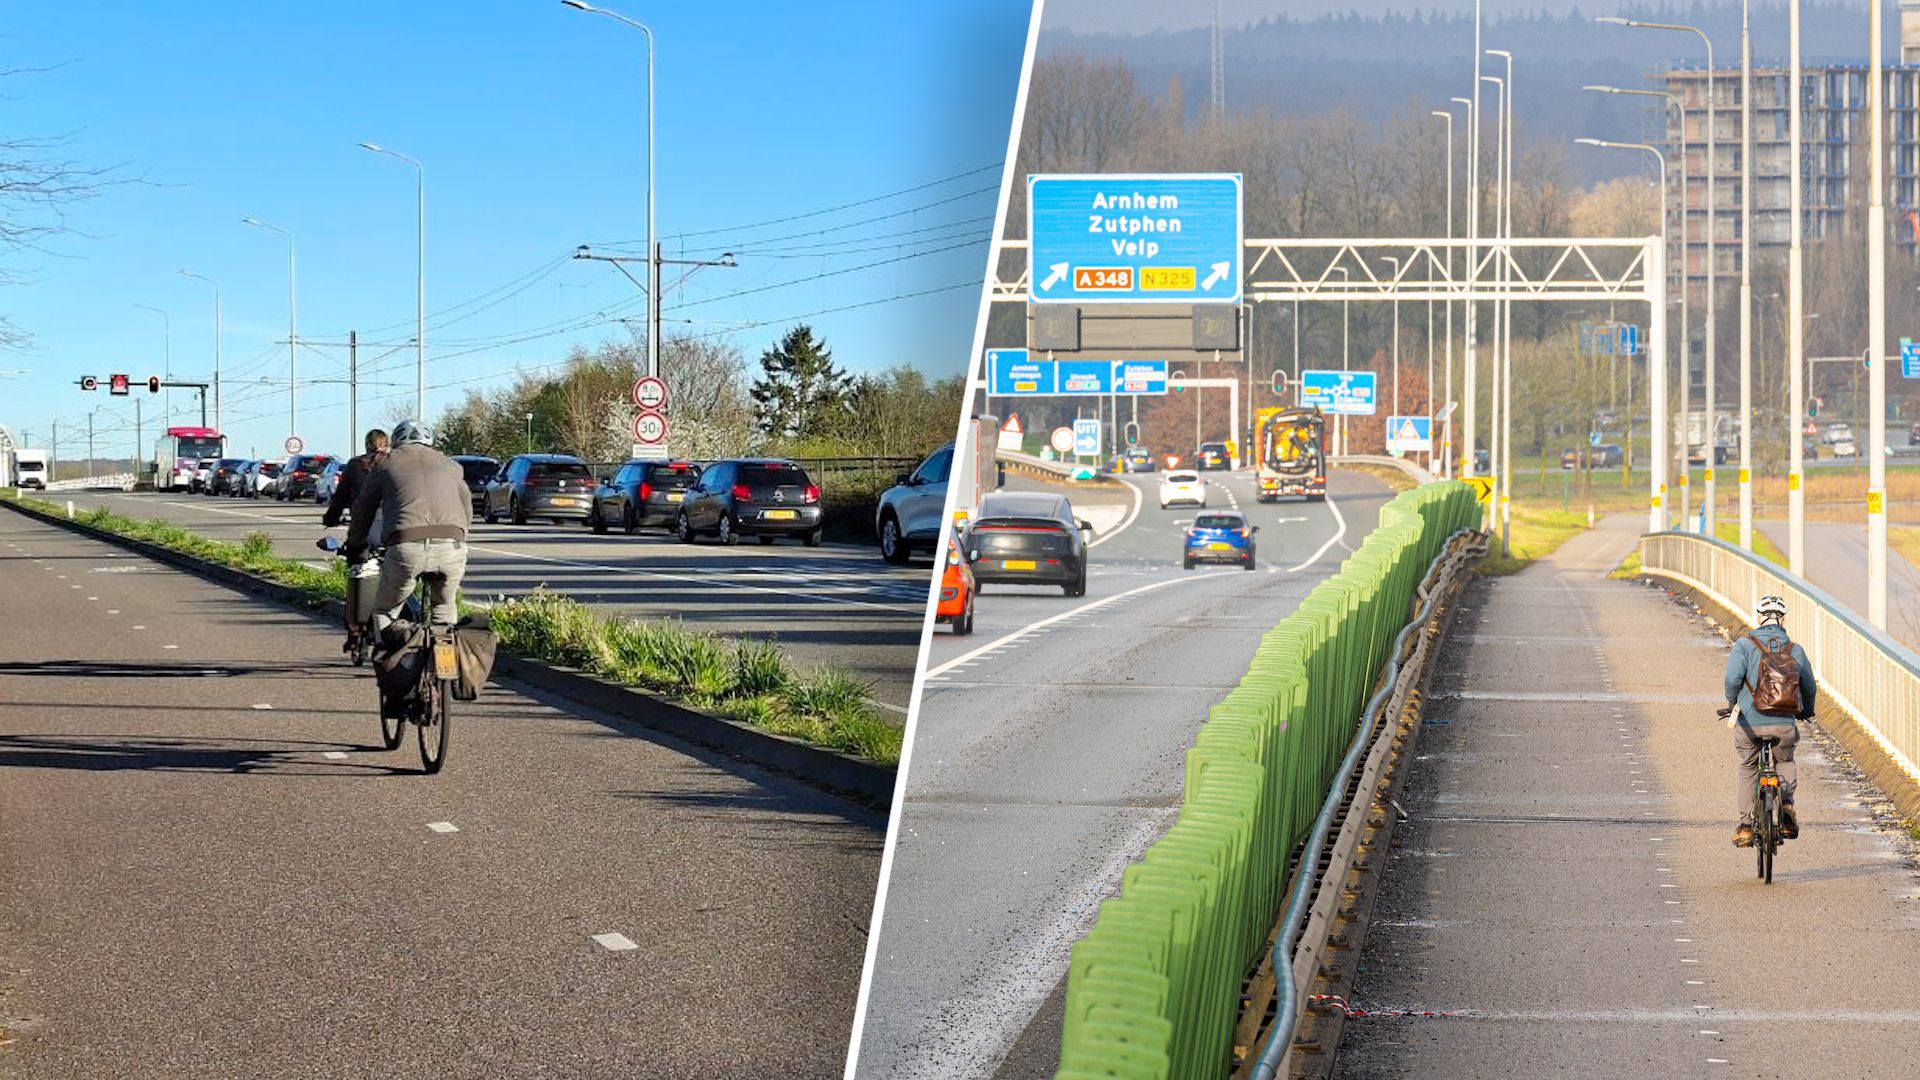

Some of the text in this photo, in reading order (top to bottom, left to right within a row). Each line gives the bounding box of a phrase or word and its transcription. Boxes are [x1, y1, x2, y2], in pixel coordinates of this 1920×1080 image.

[1092, 192, 1178, 210] Arnhem
[1088, 216, 1182, 235] Zutphen
[1111, 239, 1159, 258] Velp
[1077, 424, 1097, 434] UIT
